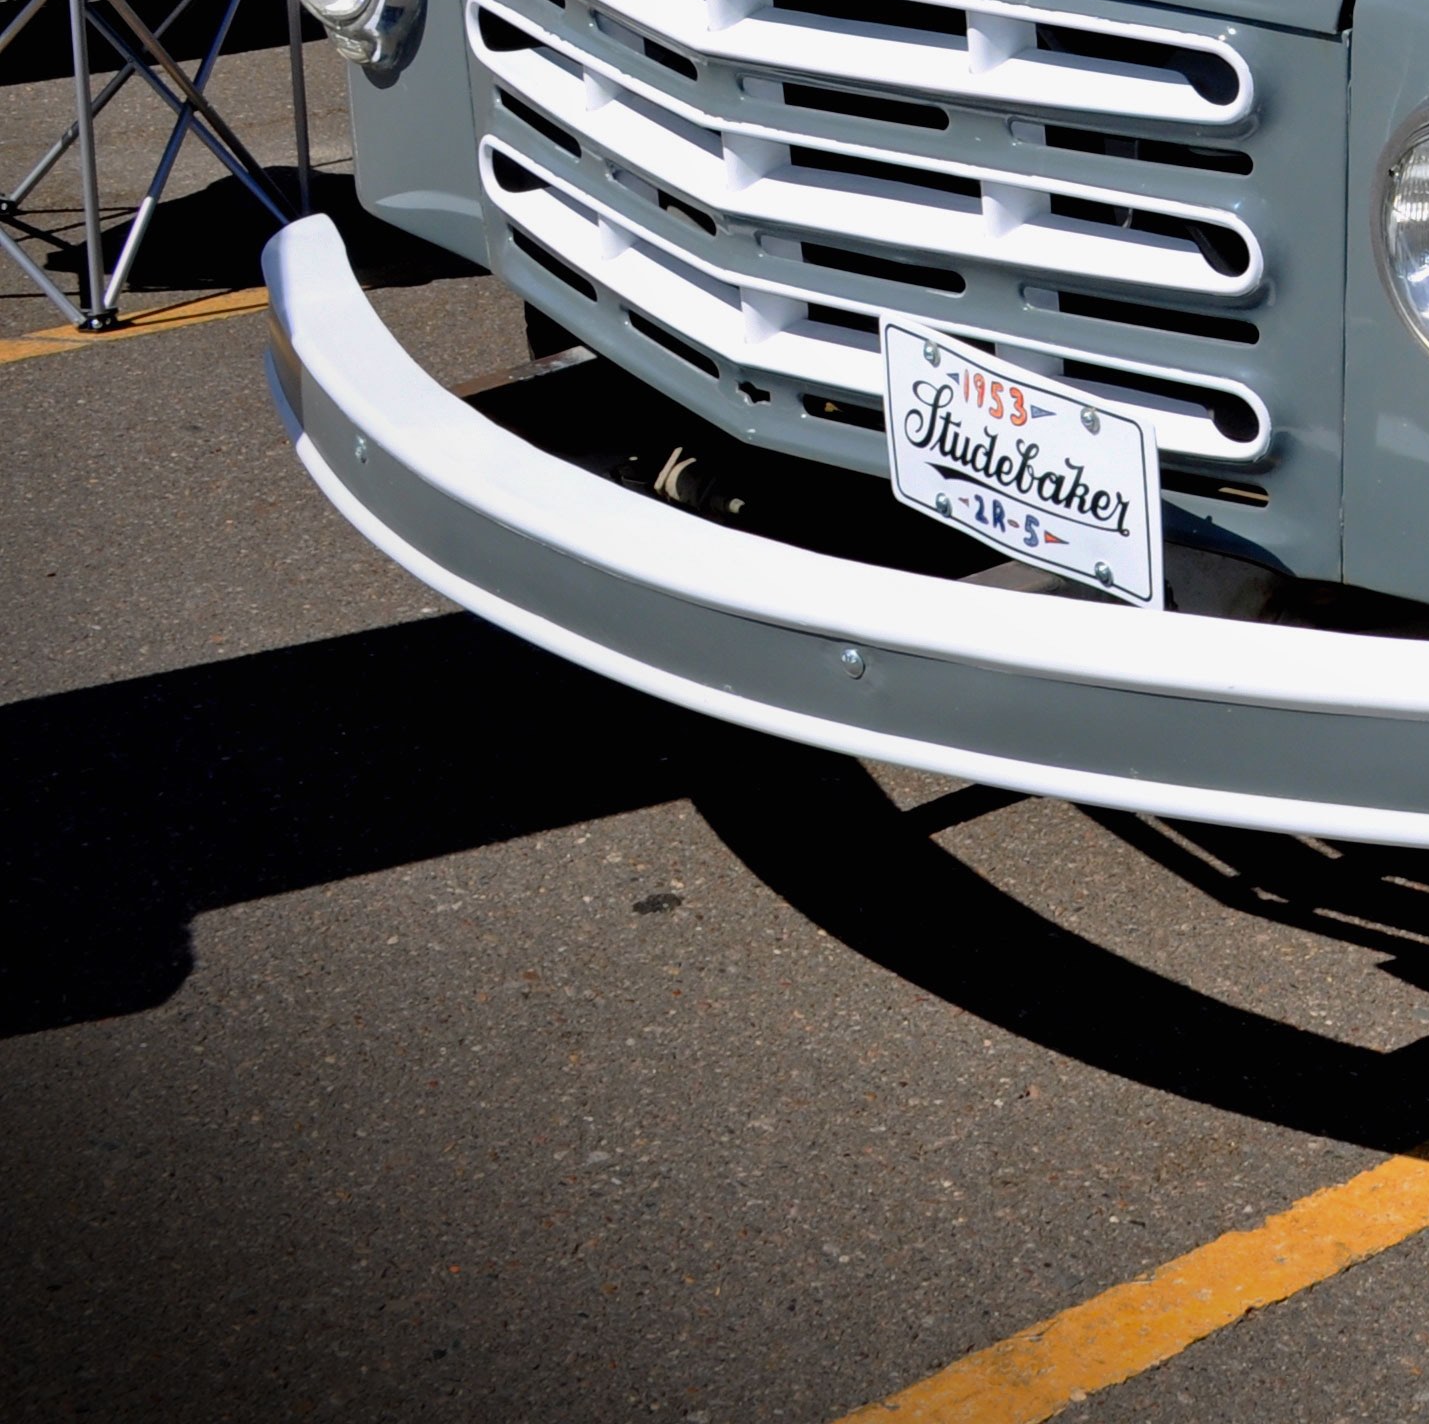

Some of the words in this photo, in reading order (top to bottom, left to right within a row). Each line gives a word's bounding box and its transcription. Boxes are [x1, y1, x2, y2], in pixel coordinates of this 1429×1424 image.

[962, 368, 1029, 427] 1953
[903, 380, 1131, 533] Studebaker
[973, 493, 1041, 548] 2R-5
